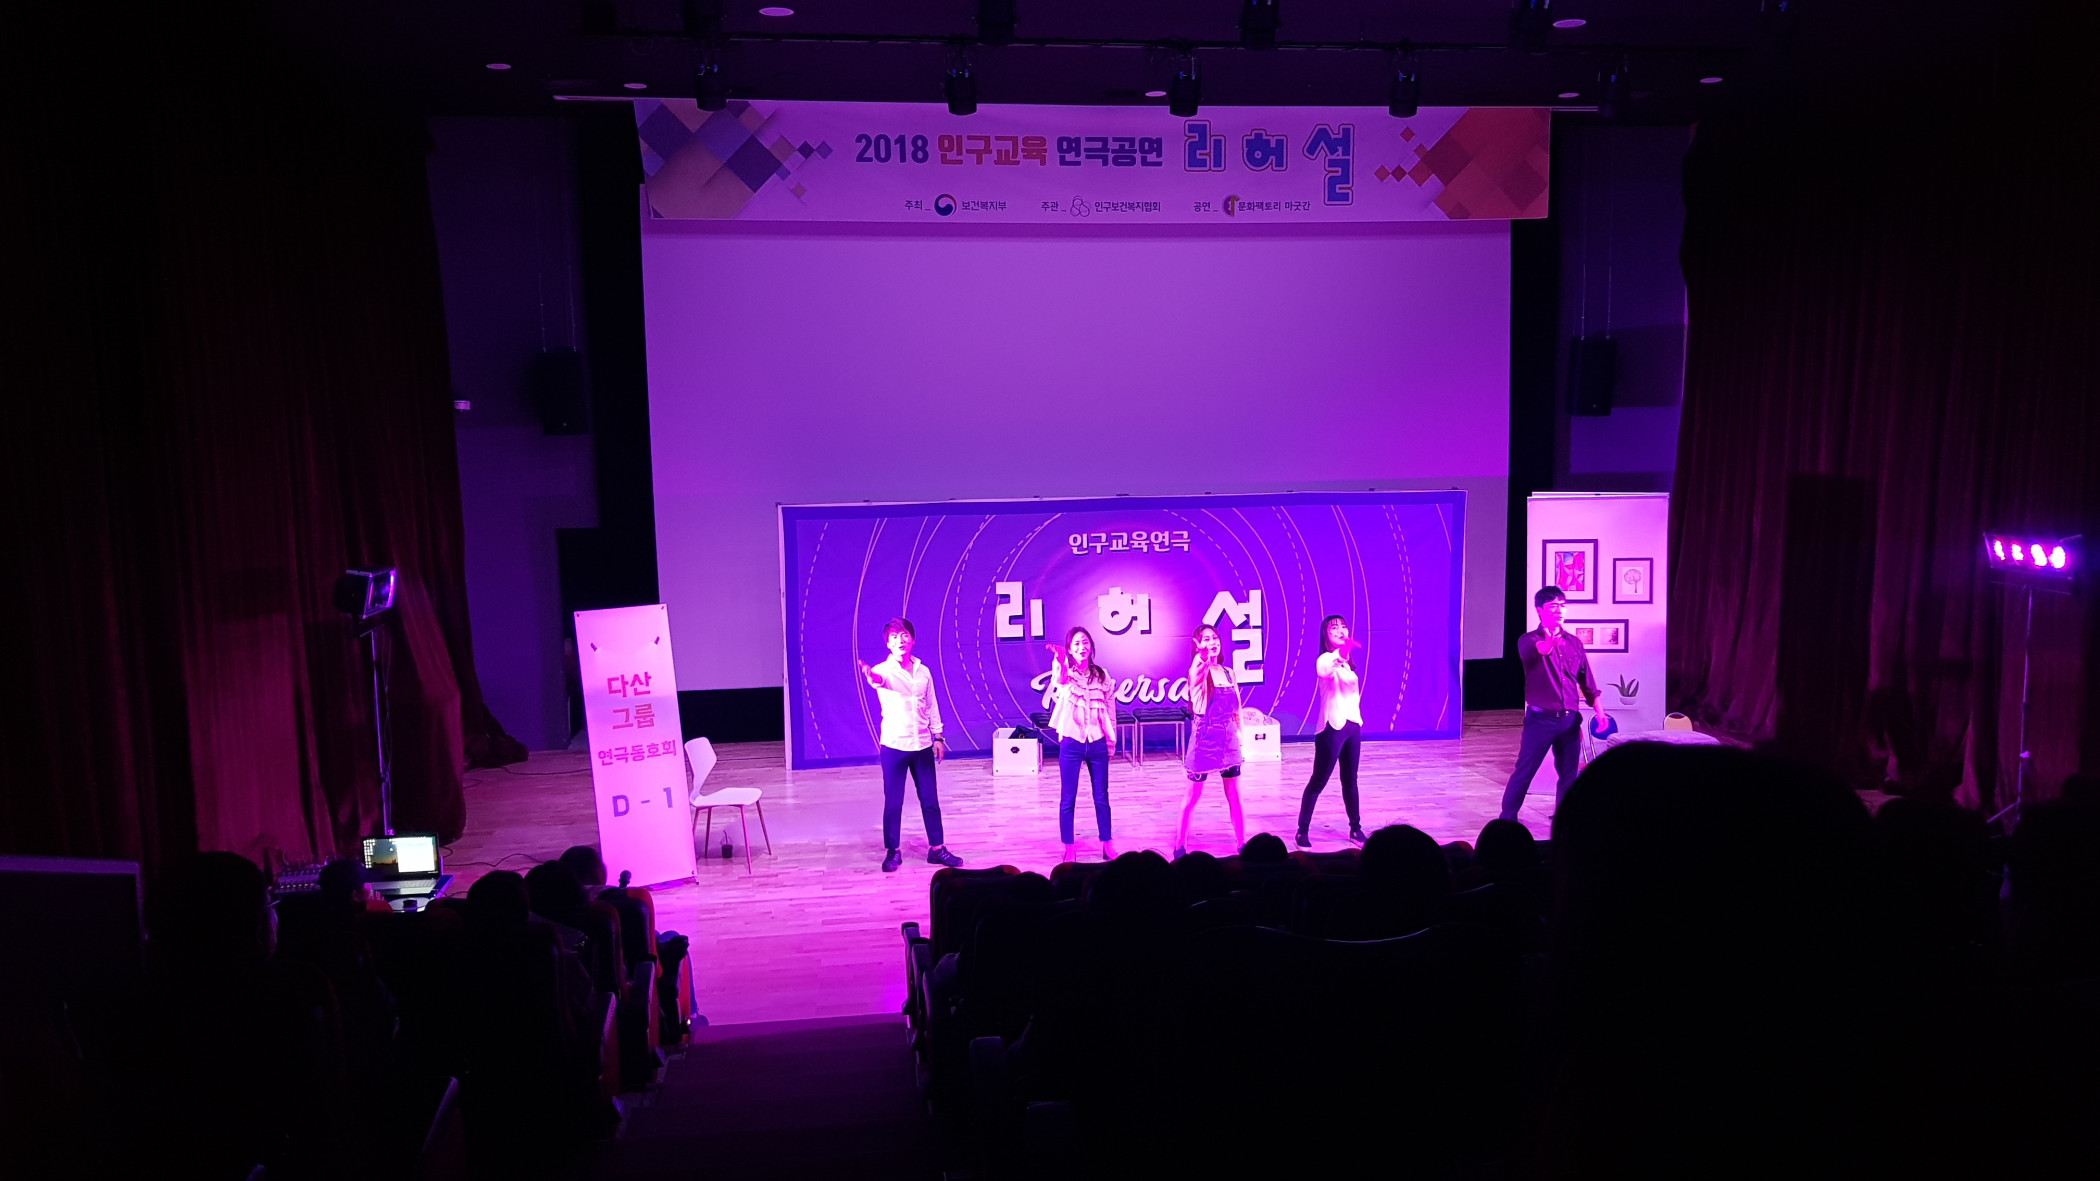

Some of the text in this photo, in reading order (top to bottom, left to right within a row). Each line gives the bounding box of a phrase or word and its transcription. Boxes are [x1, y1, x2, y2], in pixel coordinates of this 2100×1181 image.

[855, 133, 929, 164] 2018
[937, 134, 1048, 167] 인구교육
[1056, 135, 1164, 167] 연극공연
[961, 200, 1007, 212] 보건복지부
[1094, 200, 1161, 213] 인구보건복지협회
[1237, 201, 1281, 212] 문화팩토리
[1068, 530, 1191, 555] 인구교육연극
[607, 671, 652, 698] 다산
[612, 703, 655, 730] 그룹
[597, 739, 677, 766] 연극동호회
